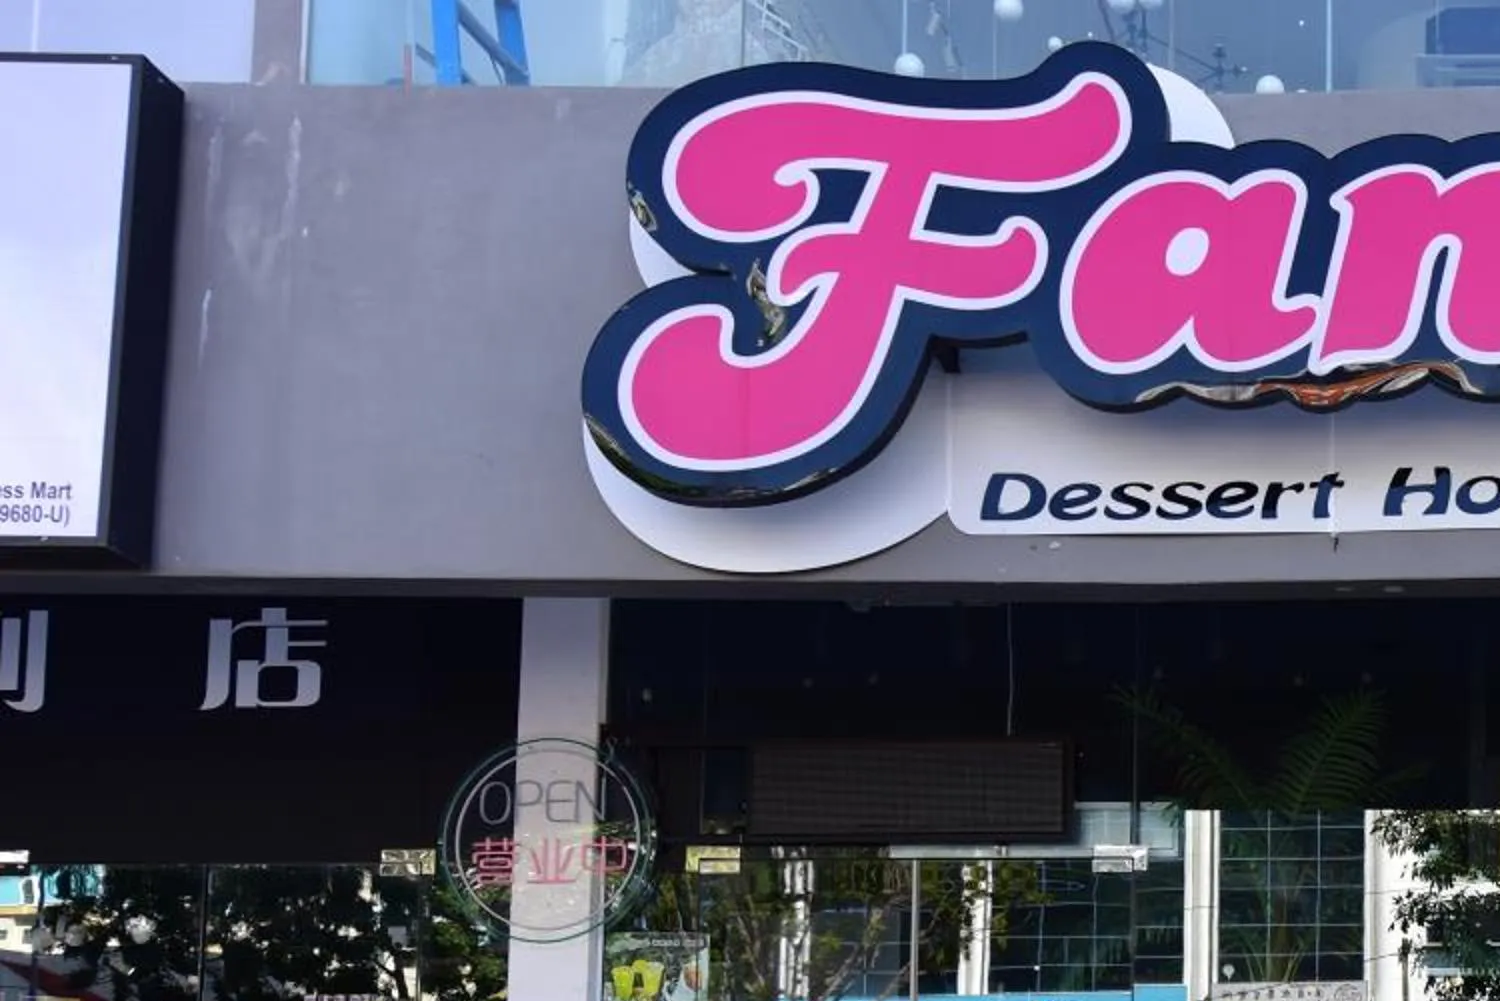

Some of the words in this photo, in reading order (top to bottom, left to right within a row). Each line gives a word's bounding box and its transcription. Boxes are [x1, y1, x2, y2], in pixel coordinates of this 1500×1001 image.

[0, 485, 24, 499] ss
[31, 481, 72, 500] Mart
[980, 471, 1344, 521] Dessert
[479, 779, 606, 825] OPEN
[472, 836, 627, 884] 营业中
